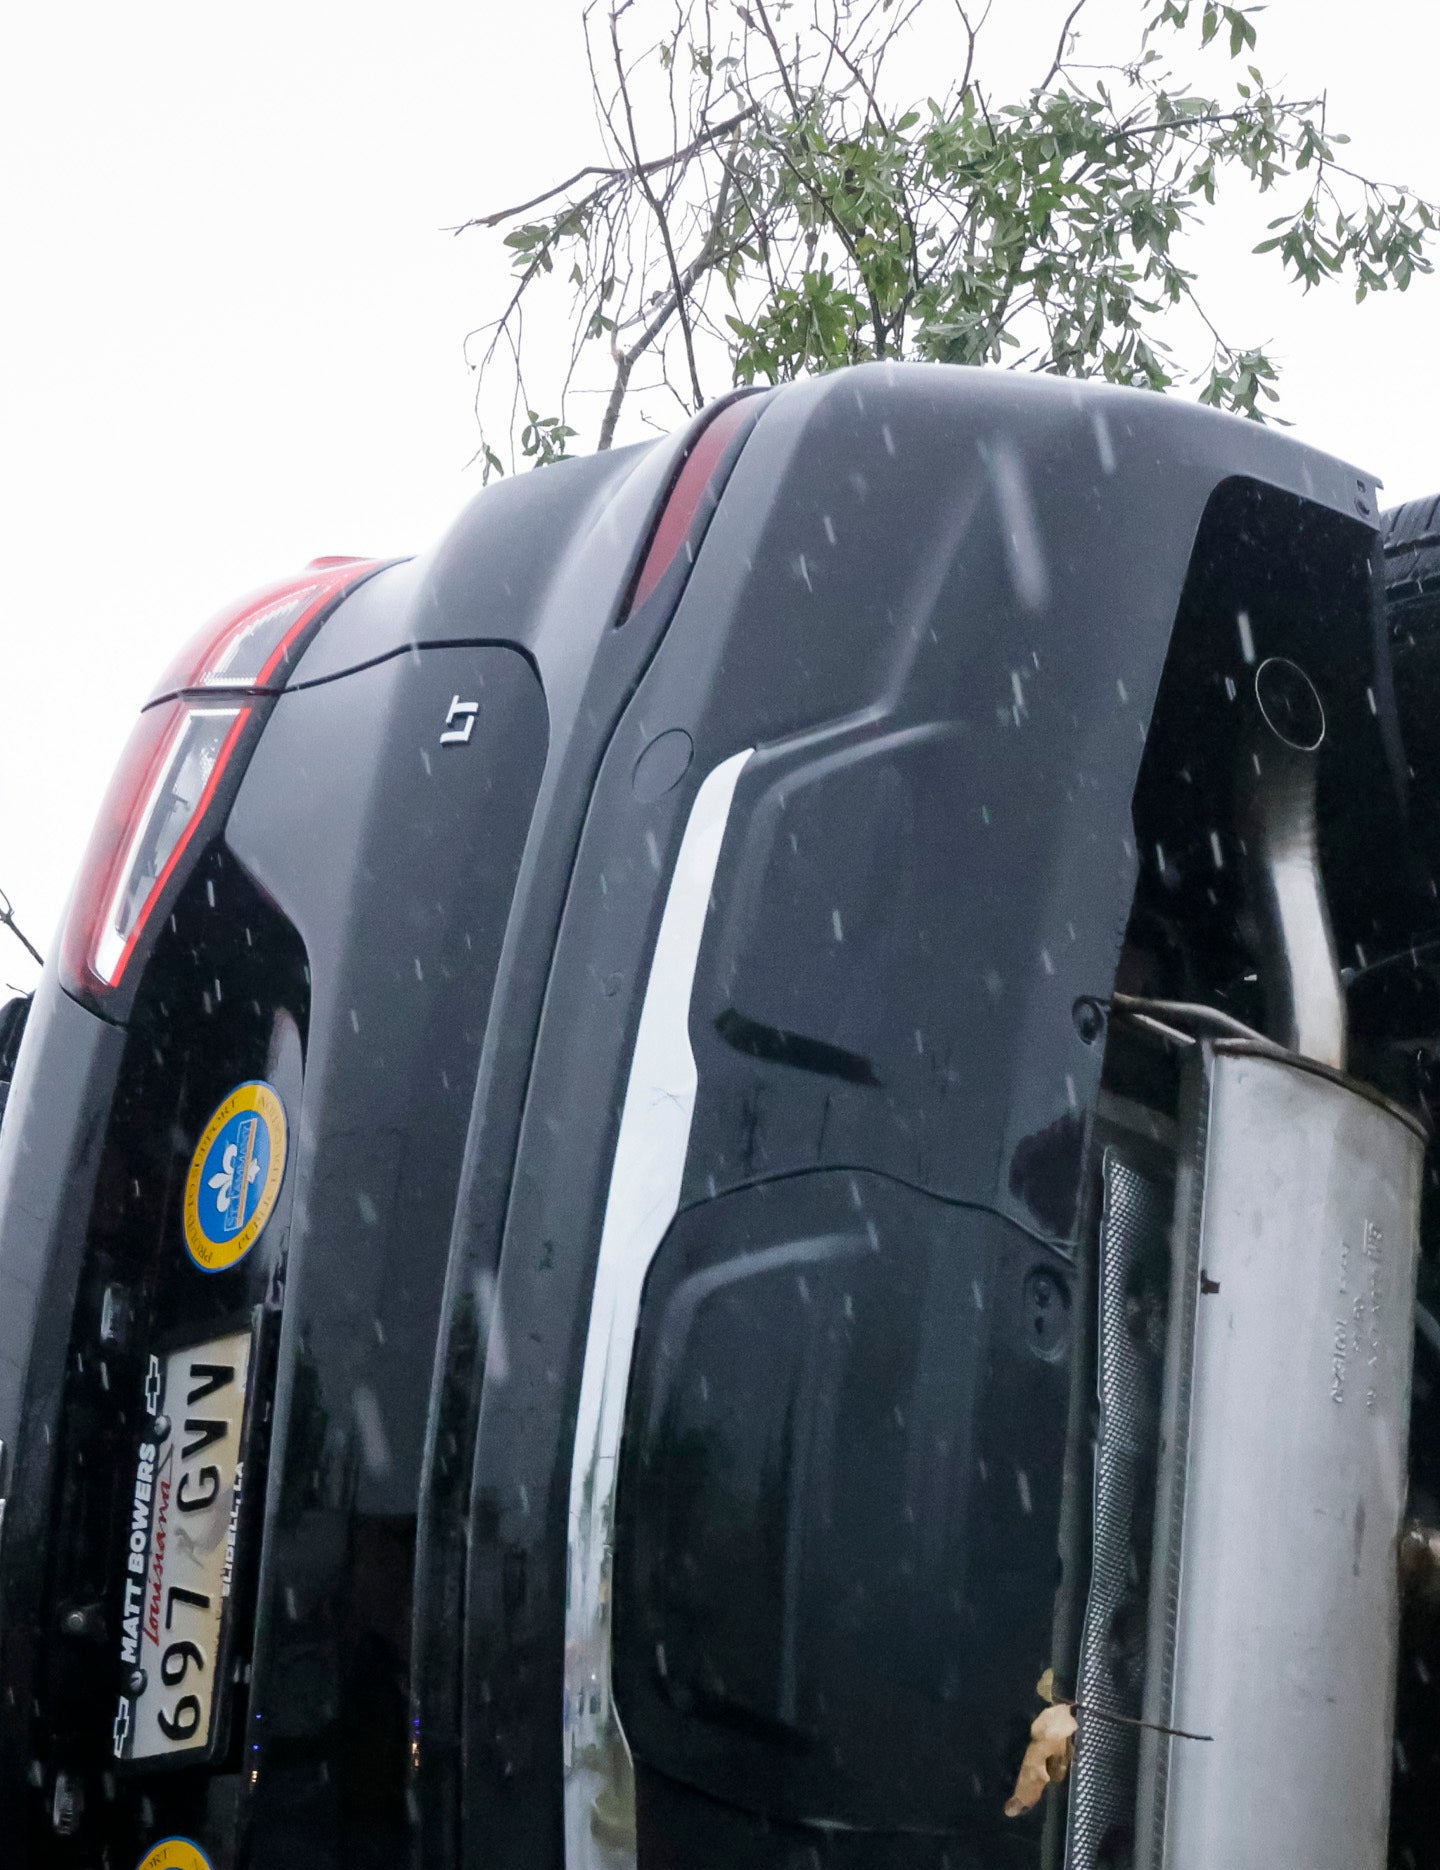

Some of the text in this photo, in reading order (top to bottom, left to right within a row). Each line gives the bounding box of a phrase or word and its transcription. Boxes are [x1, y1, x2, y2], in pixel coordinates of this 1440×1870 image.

[440, 694, 479, 744] LT
[121, 1442, 156, 1663] MATT BOWERS
[143, 1477, 172, 1647] Louisiana
[157, 1363, 234, 1741] 697 GVV
